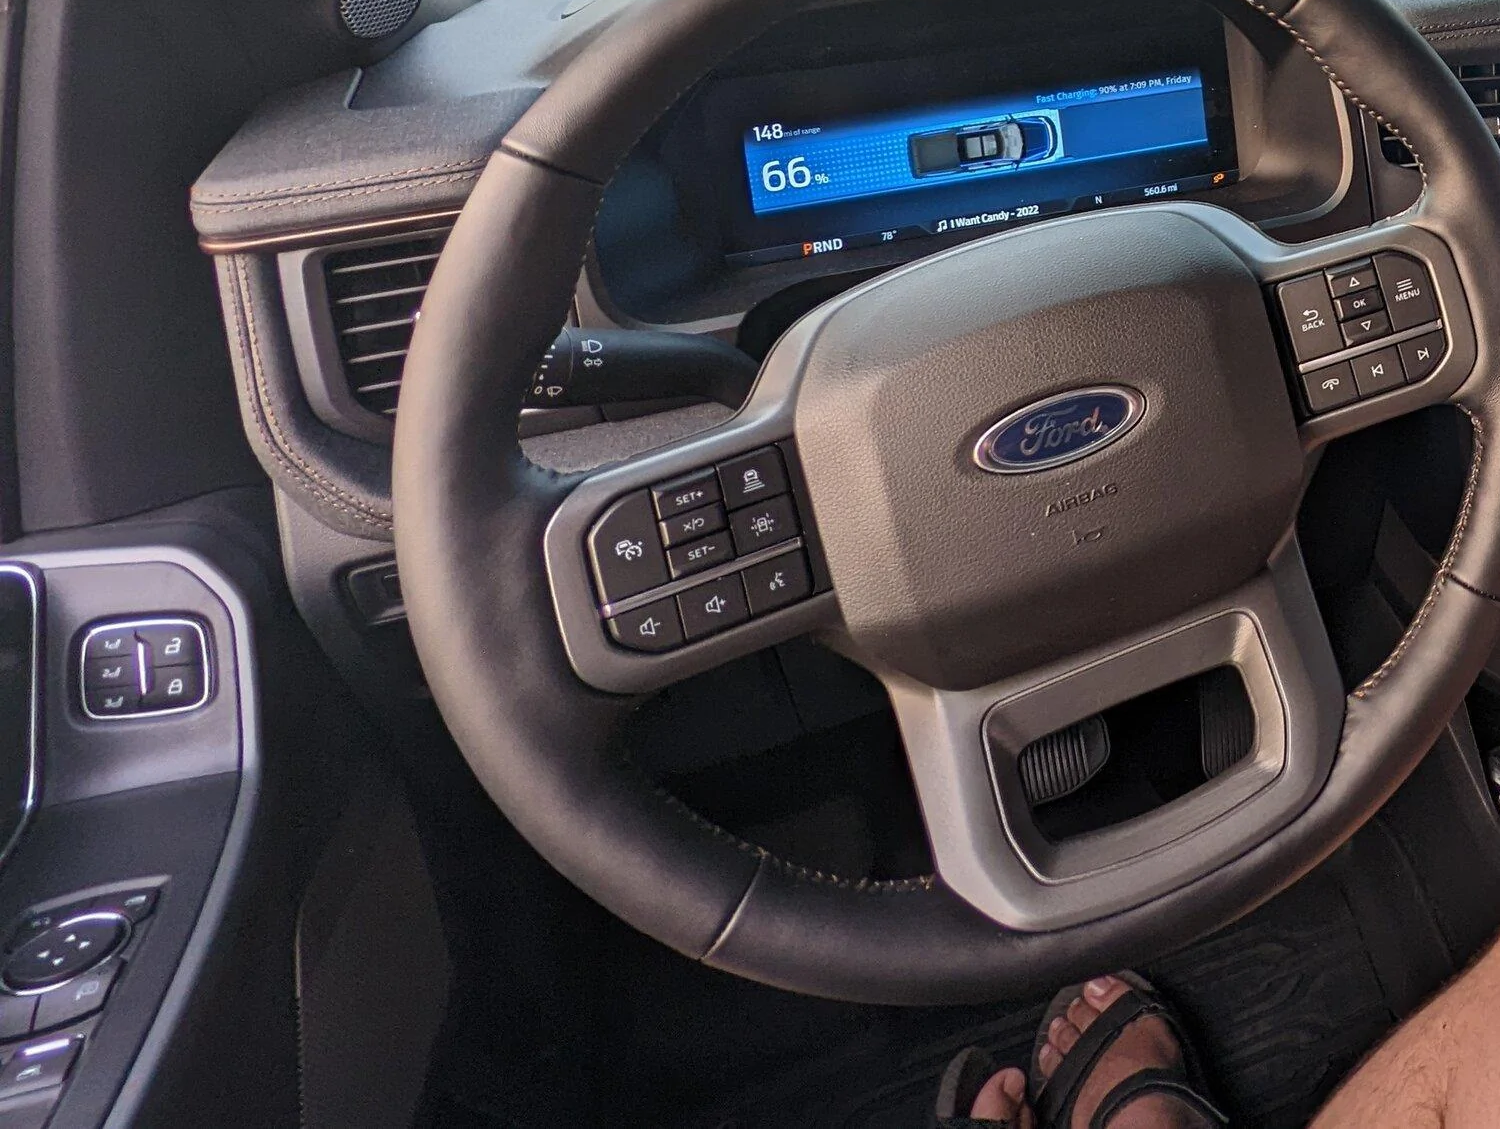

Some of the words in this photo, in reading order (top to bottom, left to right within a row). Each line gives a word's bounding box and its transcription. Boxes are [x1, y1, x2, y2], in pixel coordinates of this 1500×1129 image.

[1036, 92, 1056, 104] Fast
[1057, 87, 1098, 102] Charging:
[1099, 84, 1117, 95] 90%
[1119, 83, 1129, 92] at
[1130, 79, 1147, 90] 7:09
[1149, 78, 1165, 88] PM,
[1166, 74, 1192, 86] Friday
[753, 123, 784, 142] 148
[793, 129, 801, 137] of
[801, 126, 821, 135] range
[1144, 184, 1167, 197] 560.6
[1167, 183, 1178, 193] mi
[1094, 195, 1102, 205] N
[956, 215, 980, 228] Want
[981, 210, 1010, 225] Candy
[1016, 205, 1039, 218] 2022
[881, 230, 897, 241] 78°
[1394, 288, 1421, 302] MENU
[1352, 298, 1366, 309] OK
[1301, 319, 1326, 333] BACK
[1020, 405, 1107, 456] Ford
[675, 489, 704, 507] SET+
[1046, 483, 1118, 517] AIRBAG
